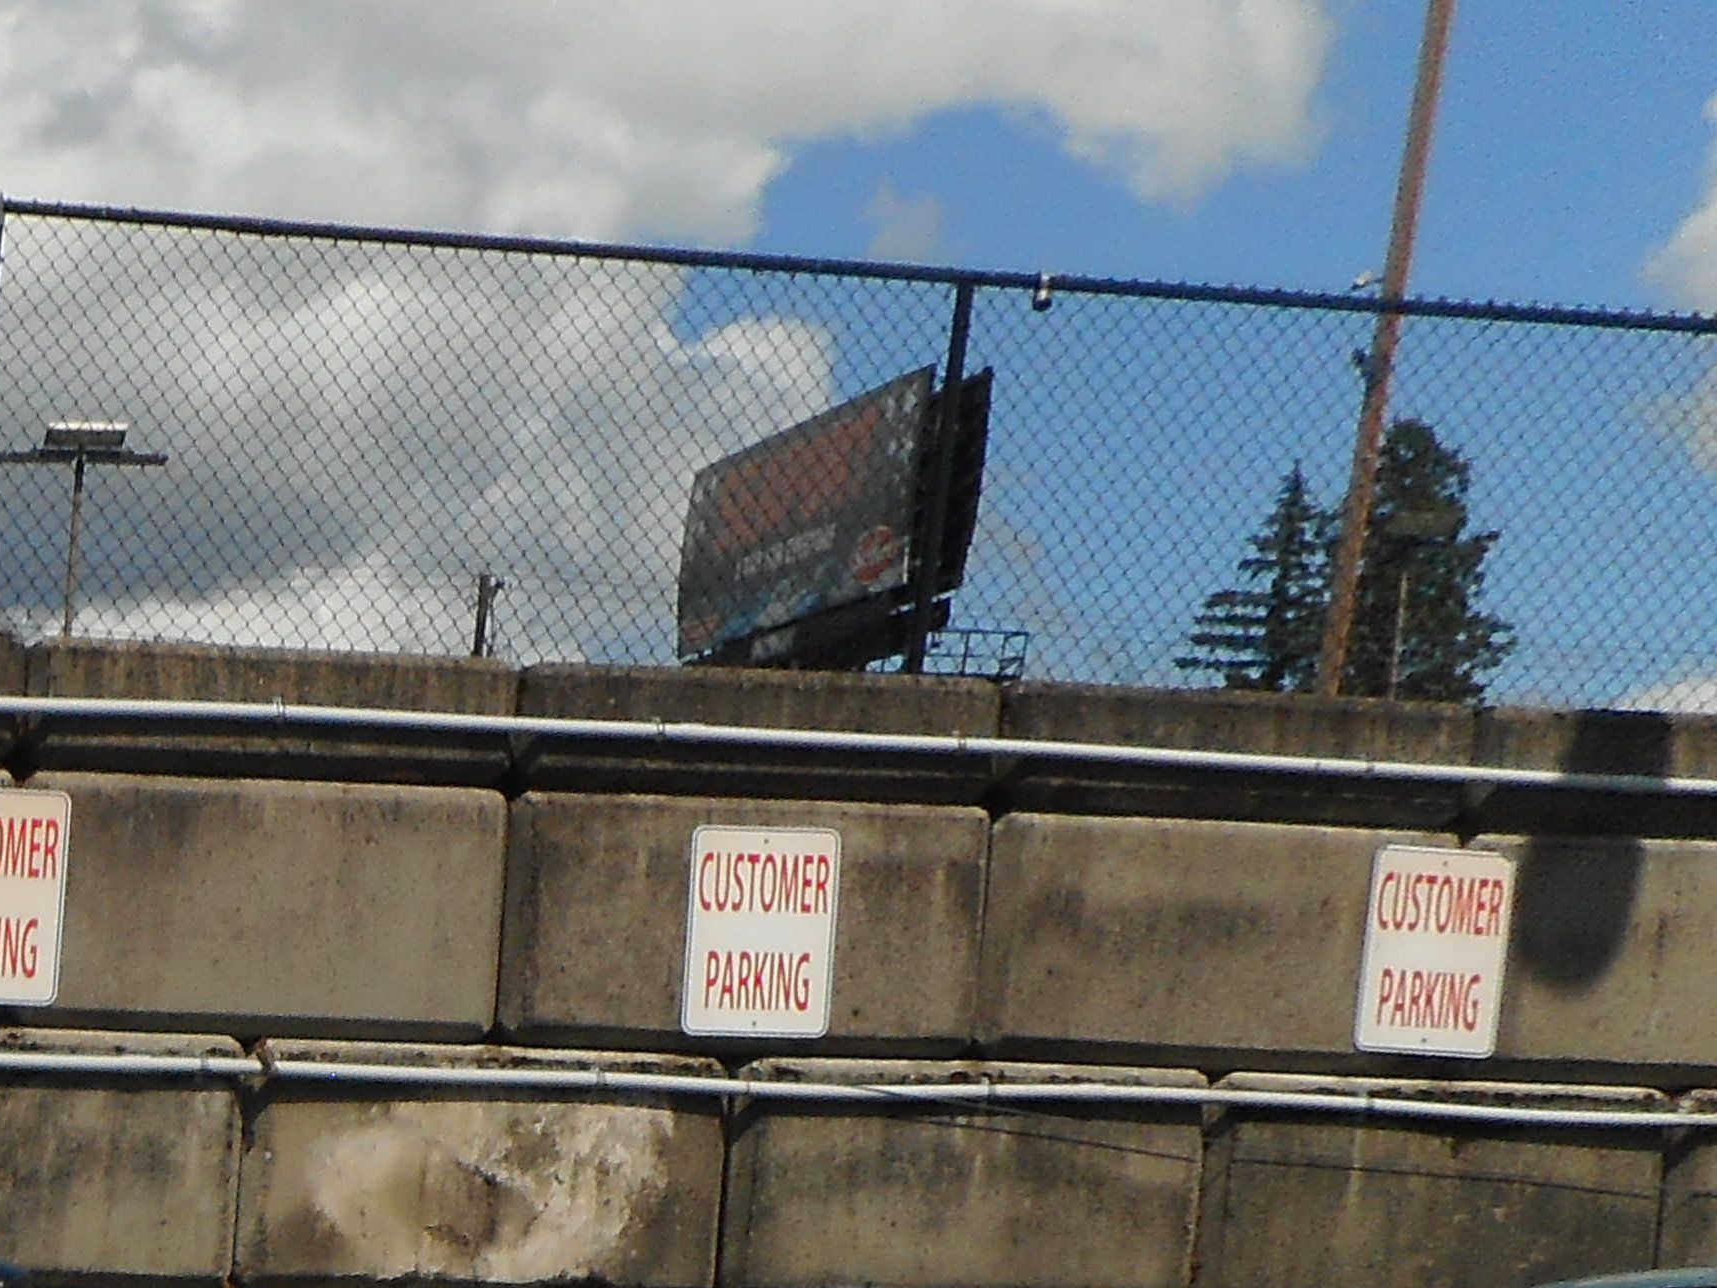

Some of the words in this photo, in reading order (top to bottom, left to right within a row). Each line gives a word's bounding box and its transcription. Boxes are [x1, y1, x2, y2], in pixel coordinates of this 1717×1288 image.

[699, 851, 830, 914] CUSTOMER
[1377, 871, 1504, 936] CUSTOMER
[703, 950, 811, 1012] PARKING
[1376, 967, 1482, 1032] PARKING
